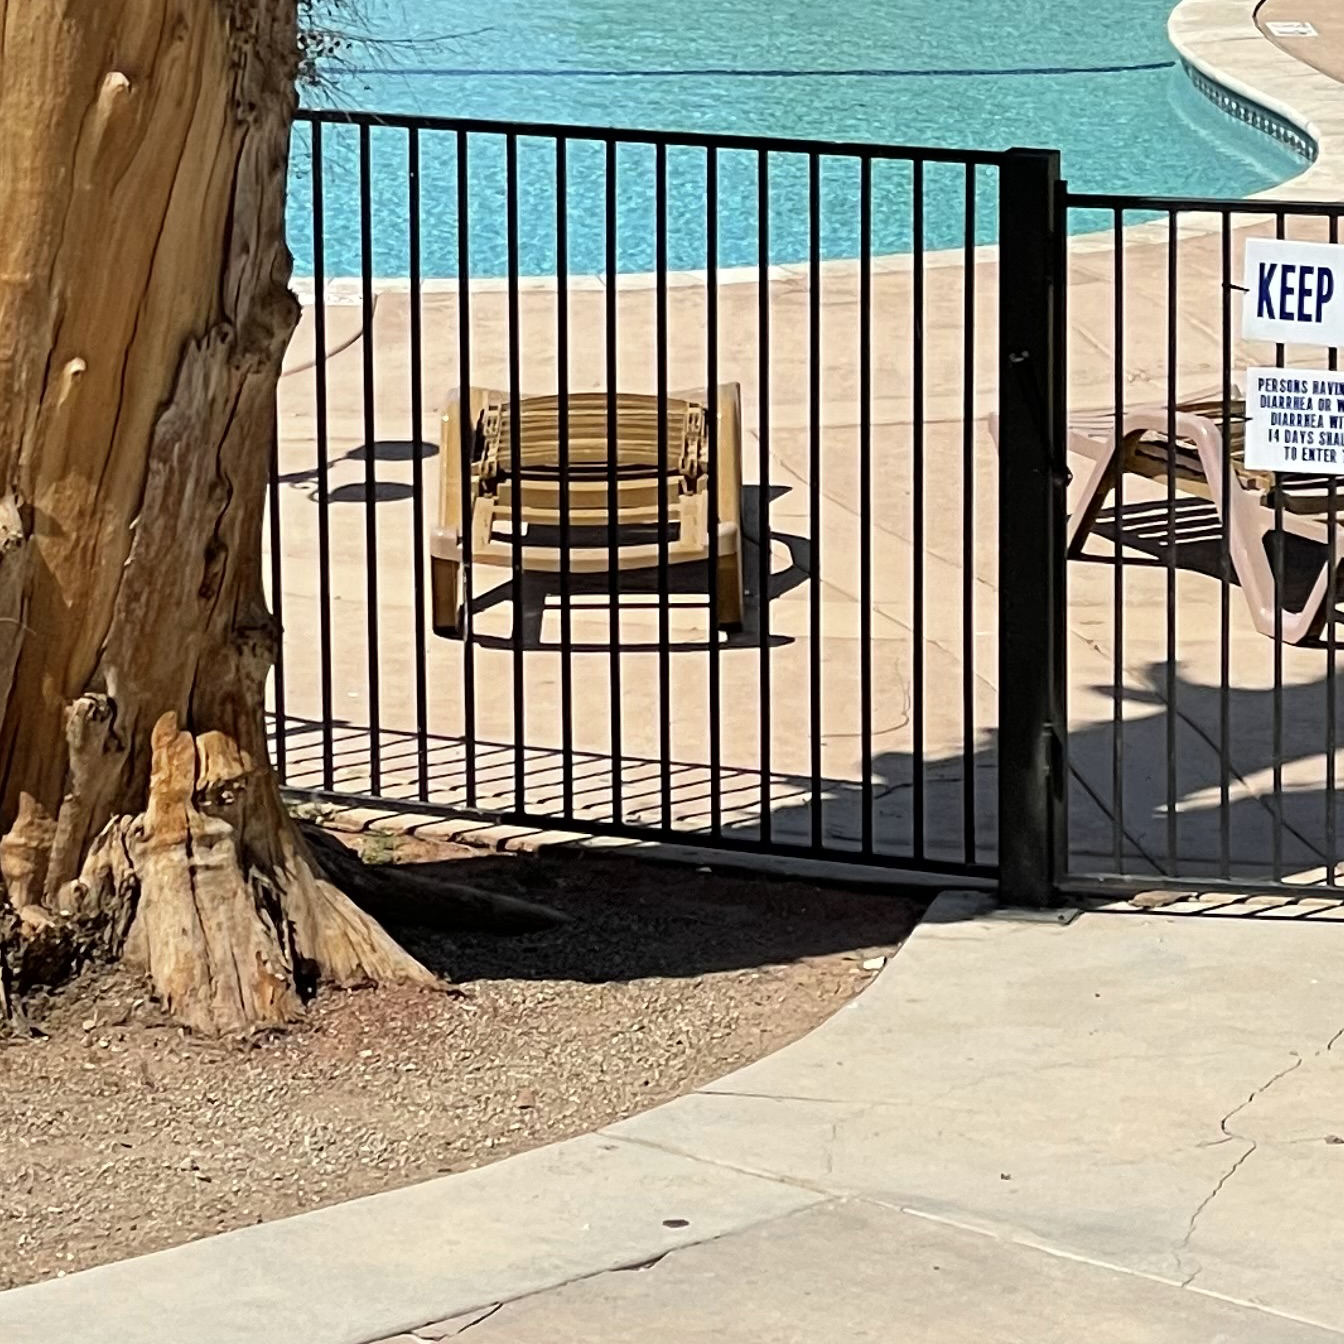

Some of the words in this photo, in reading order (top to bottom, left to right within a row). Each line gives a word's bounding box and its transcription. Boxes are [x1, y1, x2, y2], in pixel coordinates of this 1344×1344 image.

[1257, 263, 1333, 323] KEEP
[1257, 377, 1308, 394] PERSONS
[1259, 394, 1313, 410] DIARRHEA
[1317, 397, 1331, 411] OR
[1270, 411, 1324, 428] DIARRHEA
[1268, 428, 1279, 442] 14
[1284, 428, 1313, 444] DAYS
[1283, 445, 1296, 461] TO
[1301, 446, 1336, 463] ENTER
